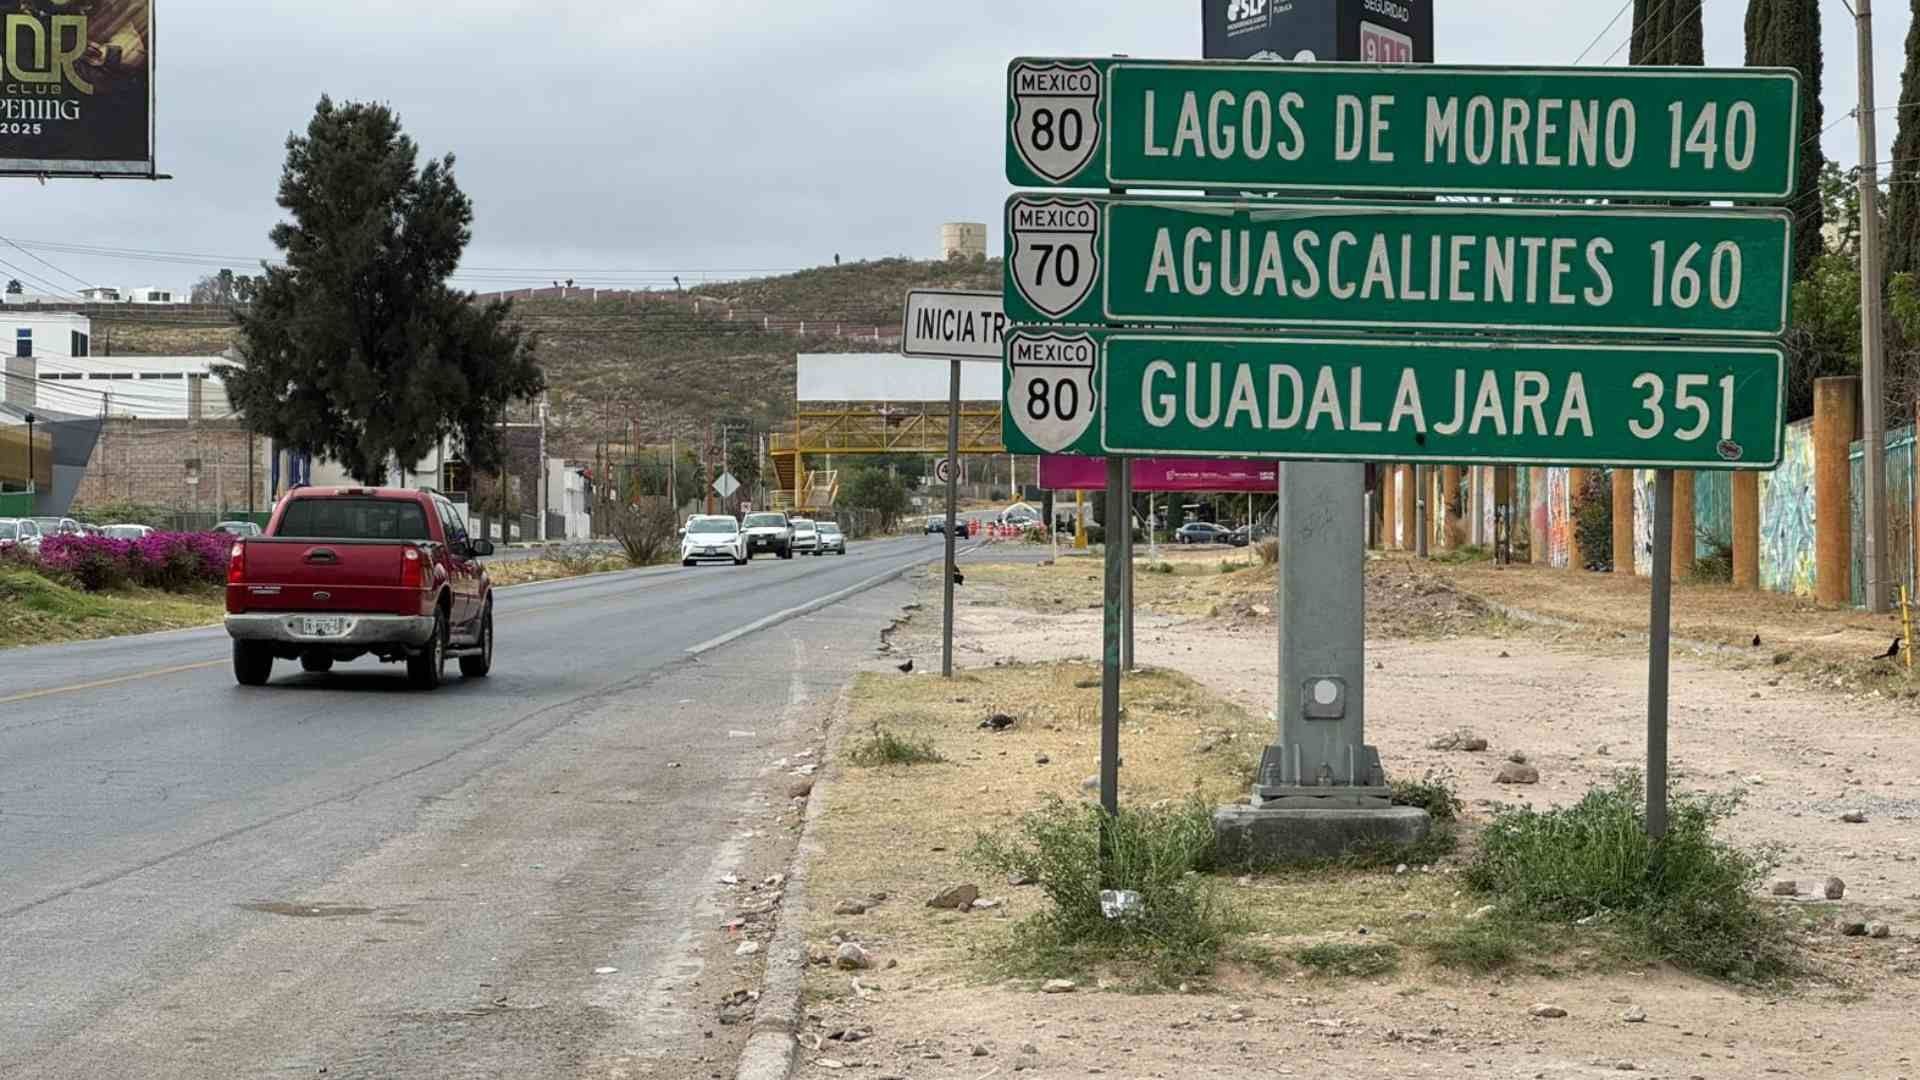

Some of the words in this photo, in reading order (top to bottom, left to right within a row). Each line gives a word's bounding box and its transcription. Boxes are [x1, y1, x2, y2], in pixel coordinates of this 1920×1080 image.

[1367, 38, 1407, 63] 911
[6, 84, 62, 94] CLUB
[1021, 73, 1092, 92] MEXICO
[0, 122, 42, 135] 2025
[1031, 107, 1083, 152] 80
[1144, 90, 1305, 161] LAGOS
[1335, 95, 1395, 162] DE
[1424, 95, 1637, 168] MORENO
[1668, 100, 1757, 171] 140
[1019, 208, 1090, 228] MEXICO
[1029, 243, 1080, 288] 70
[1145, 226, 1614, 307] AGUASCALIENTES
[1650, 239, 1743, 310] 160
[915, 308, 975, 343] INICIA
[981, 311, 1010, 344] TR
[1018, 343, 1088, 363] MEXICO
[1026, 377, 1079, 422] 80
[1141, 360, 1594, 437] GUADALAJARA
[1628, 372, 1735, 441] 351
